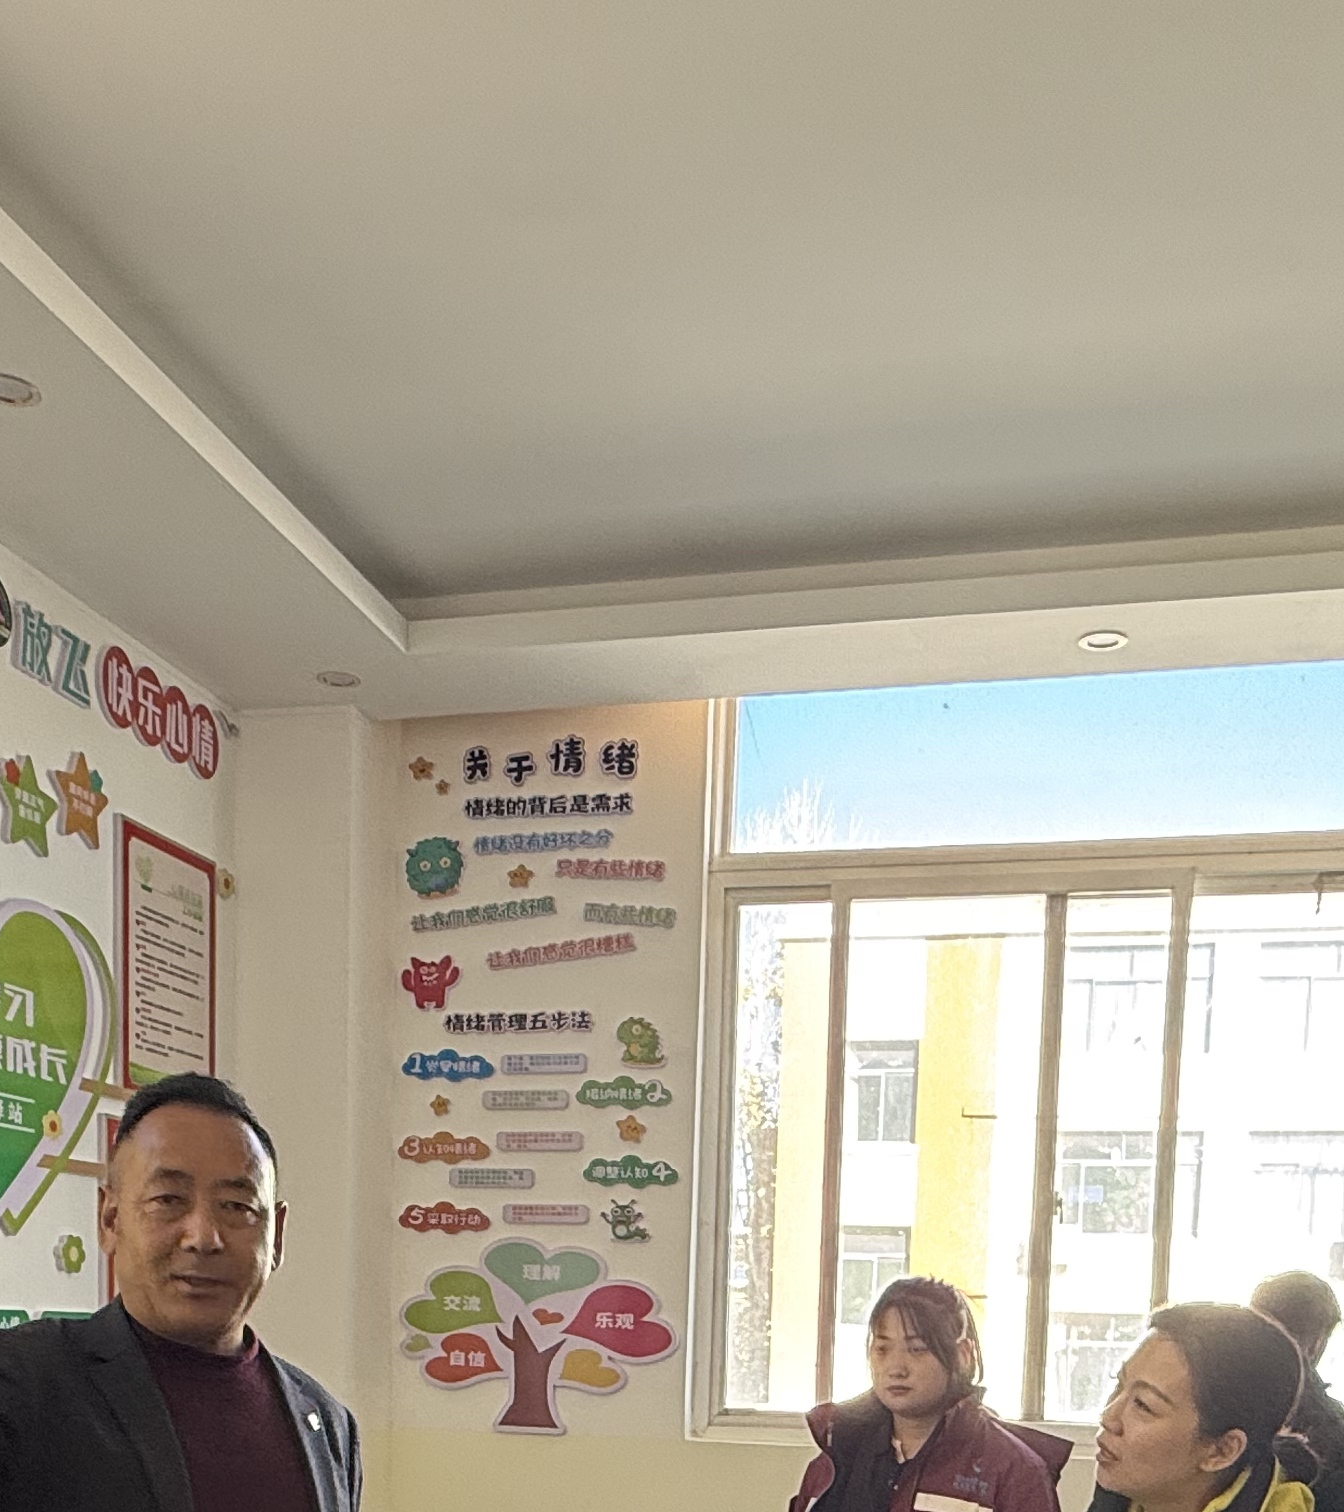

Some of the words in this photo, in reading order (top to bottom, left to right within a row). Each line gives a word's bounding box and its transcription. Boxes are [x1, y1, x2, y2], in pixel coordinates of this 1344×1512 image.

[21, 602, 91, 707] 放飞
[107, 656, 214, 772] 快乐心情
[464, 736, 638, 784] 关于情绪
[464, 793, 633, 818] 情绪的背后是需求
[474, 829, 613, 855] 情绪没有好坏之分
[556, 858, 665, 882] 只是有些情绪
[411, 896, 556, 932] 让我们感觉很舒服
[446, 1012, 593, 1033] 情绪管理五步法
[410, 1054, 422, 1073] 1
[644, 1078, 666, 1102] 2
[405, 1136, 421, 1156] 3
[652, 1161, 672, 1182] 4
[408, 1209, 424, 1225] 5
[427, 1213, 481, 1226] 采取行动
[522, 1264, 561, 1282] 理解
[443, 1295, 482, 1312] 交流
[594, 1313, 636, 1330] 乐观
[449, 1350, 486, 1368] 自信
